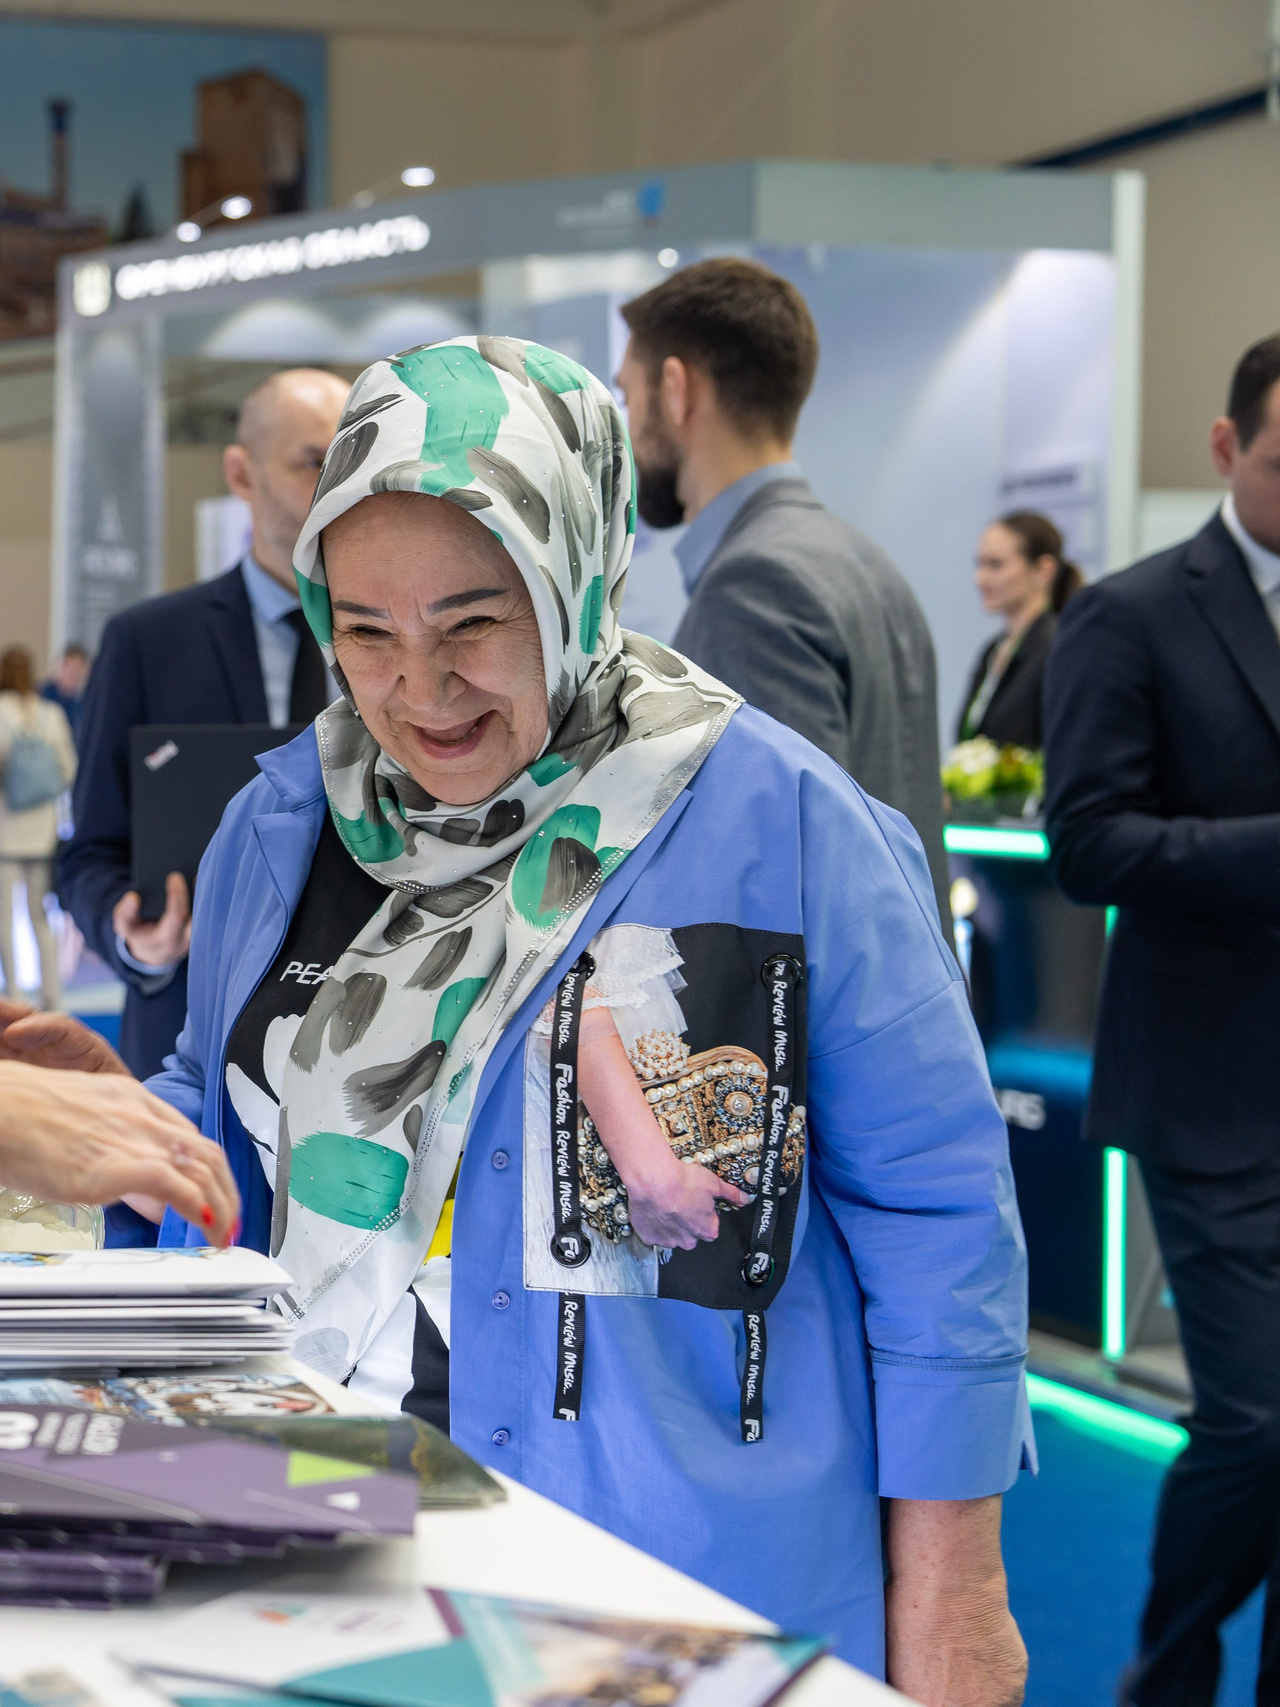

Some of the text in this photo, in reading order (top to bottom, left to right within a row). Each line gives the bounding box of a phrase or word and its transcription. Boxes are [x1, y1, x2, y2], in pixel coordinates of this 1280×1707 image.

[772, 980, 788, 1026] Review
[554, 1062, 574, 1125] Fashion
[768, 1084, 789, 1146] Fashion
[556, 1130, 570, 1182] Review
[761, 1150, 779, 1196] Review
[562, 1300, 578, 1348] Review
[747, 1314, 762, 1360] Review
